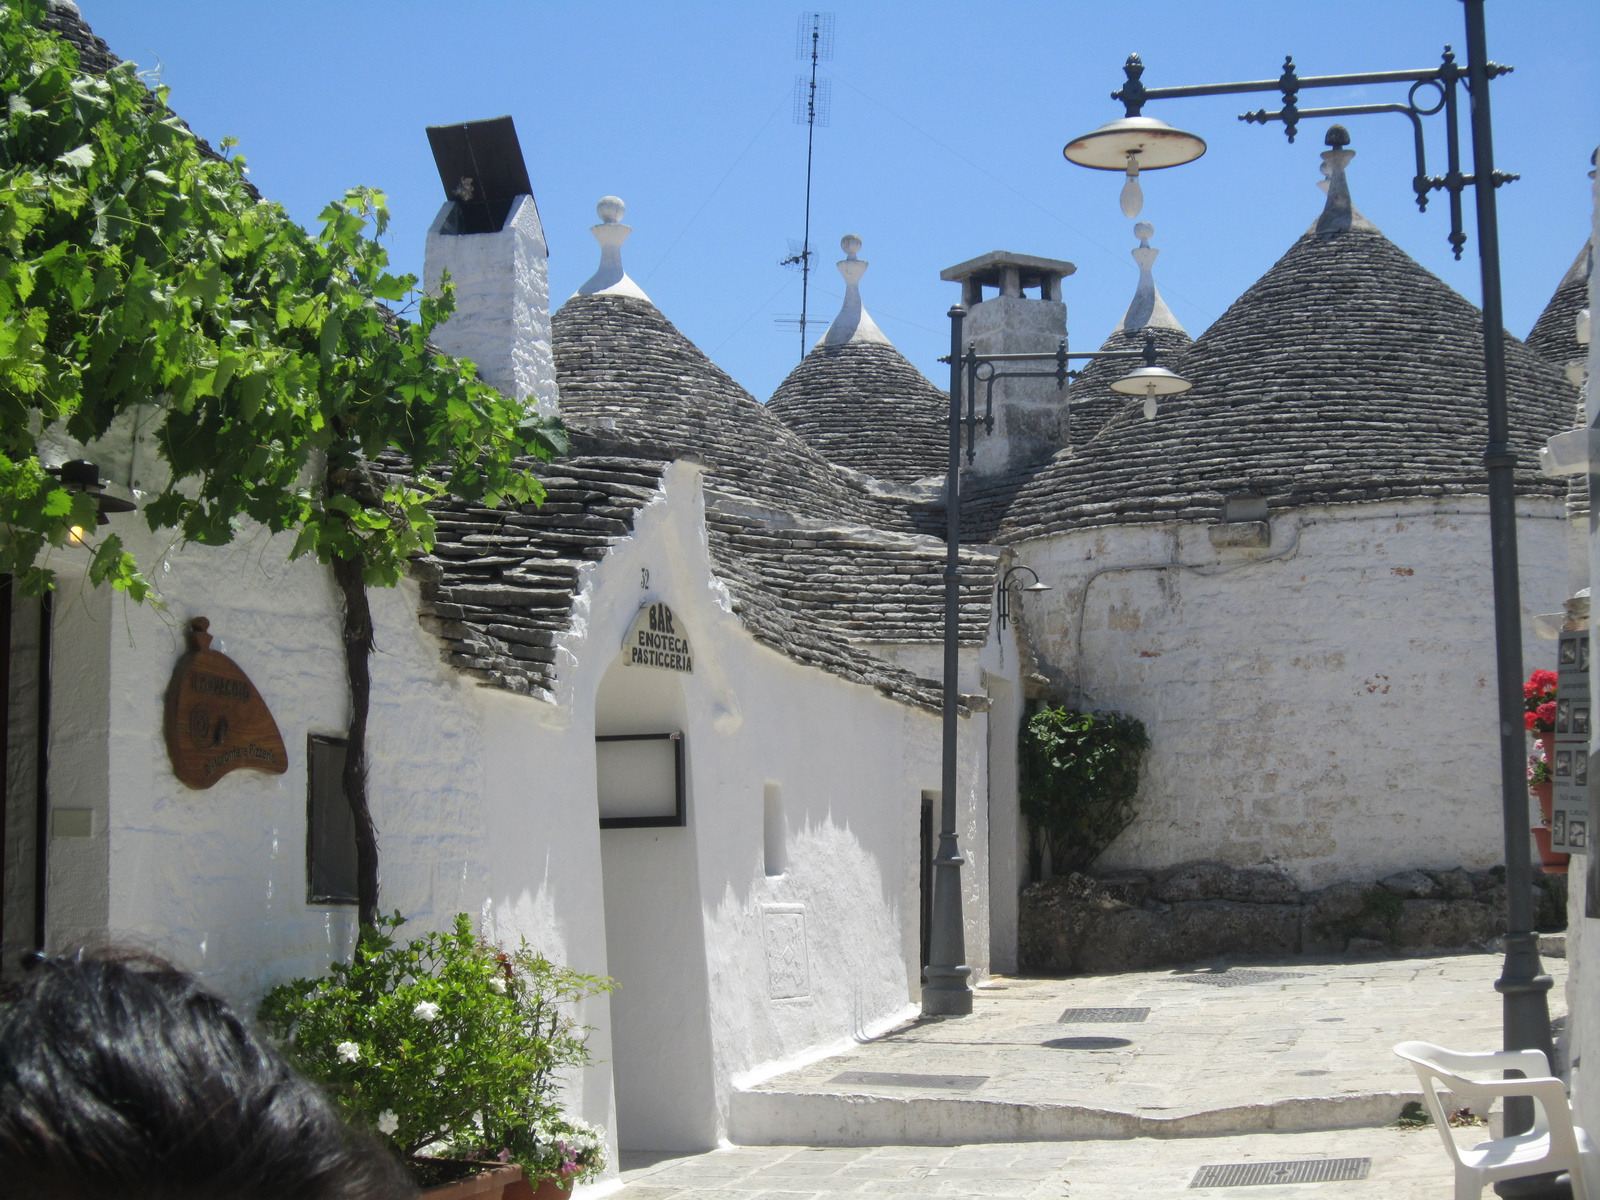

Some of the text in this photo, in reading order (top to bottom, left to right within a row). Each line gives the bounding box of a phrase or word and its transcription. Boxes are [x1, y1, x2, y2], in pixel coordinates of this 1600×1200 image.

[640, 567, 650, 590] 32
[649, 603, 674, 634] BAR
[638, 630, 688, 654] ENOTECA
[632, 647, 692, 672] PASTICCERIA
[204, 743, 277, 776] Ristorante e Pizzeria
